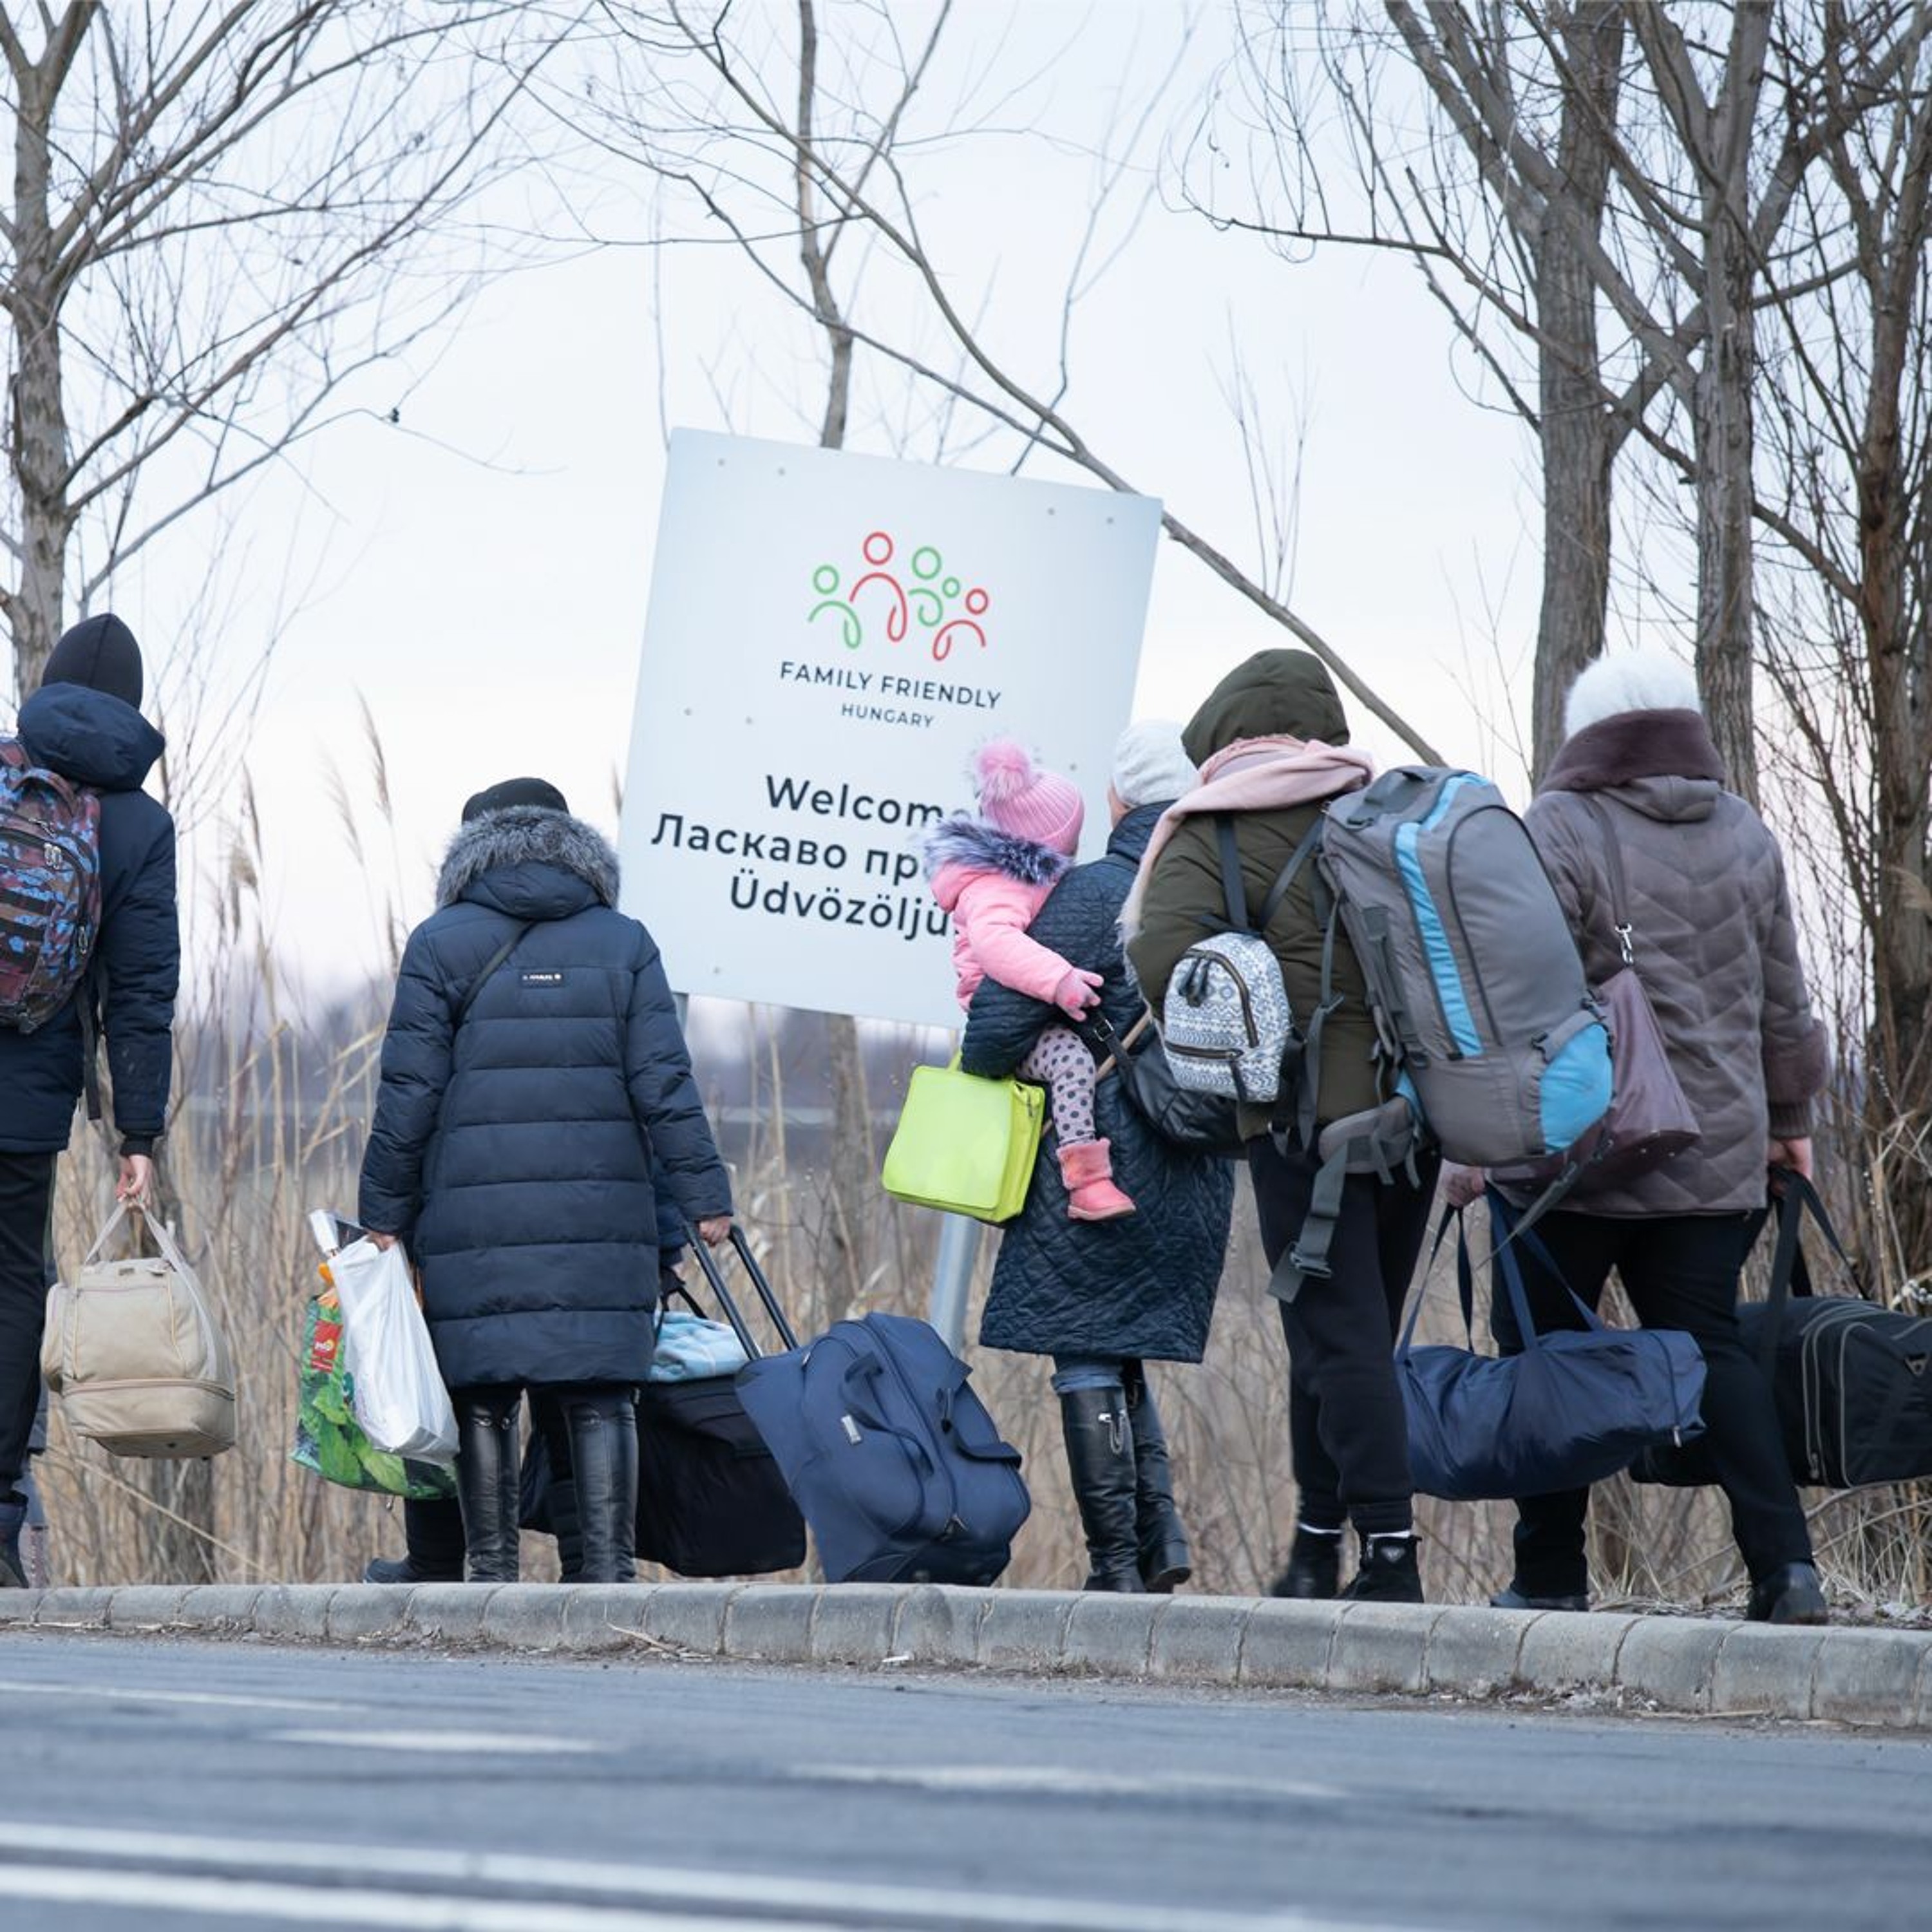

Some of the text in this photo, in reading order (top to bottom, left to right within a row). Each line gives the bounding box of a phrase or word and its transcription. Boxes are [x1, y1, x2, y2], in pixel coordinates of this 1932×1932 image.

[781, 661, 1001, 708] FAMILY FRIENDLY
[841, 703, 934, 727] HUNGARY
[766, 775, 971, 827] Welcom
[651, 813, 847, 869] Ласкаво
[730, 868, 960, 941] Üdvözöljü
